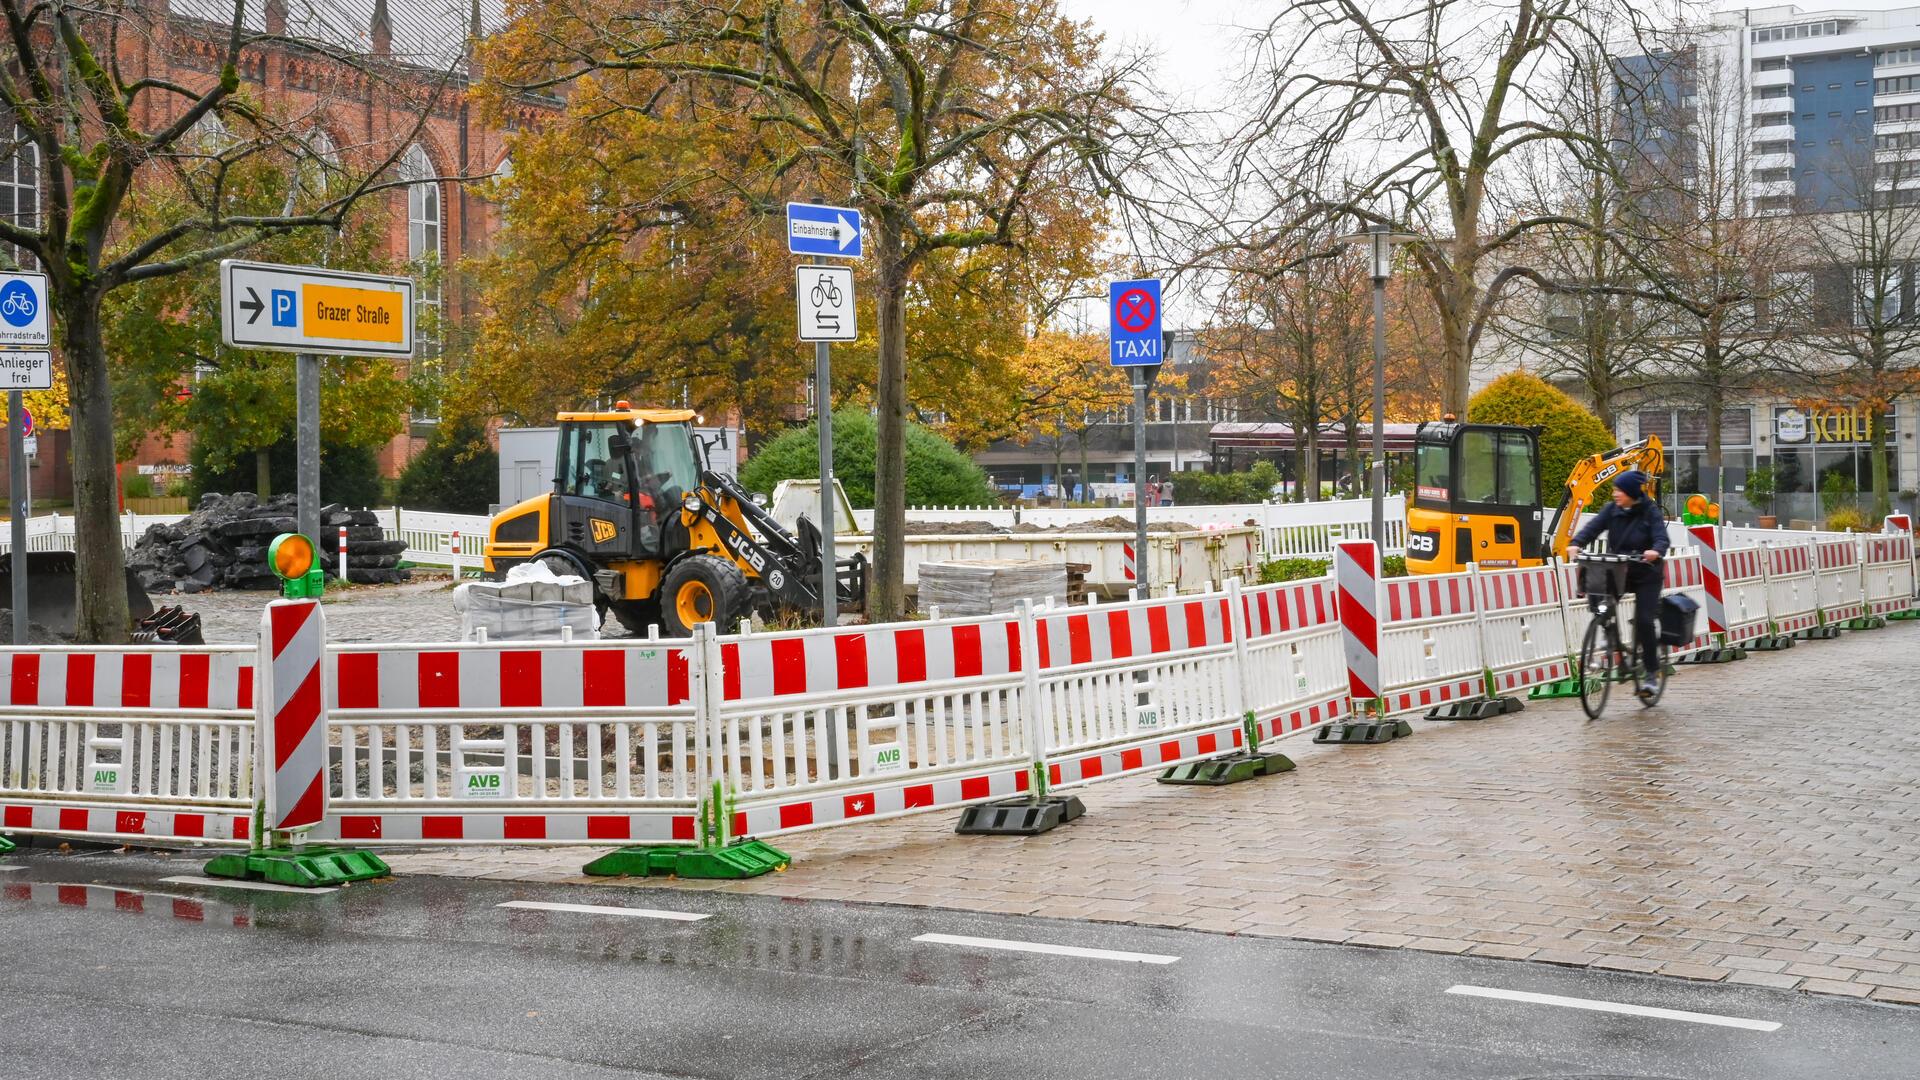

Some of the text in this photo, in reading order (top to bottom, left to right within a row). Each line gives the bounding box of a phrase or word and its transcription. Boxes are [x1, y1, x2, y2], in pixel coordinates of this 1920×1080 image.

[277, 294, 390, 325] P Grazer Straße
[0, 330, 46, 340] hrradstraße
[1115, 338, 1157, 358] TAXI
[0, 356, 43, 371] Anlieger
[12, 371, 31, 384] frei
[1593, 463, 1618, 484] JCB
[594, 520, 616, 541] JCB
[1408, 533, 1434, 552] JCB
[728, 529, 766, 573] JCB
[771, 573, 781, 586] 20
[1138, 711, 1158, 725] AVB
[877, 749, 901, 764] AVB
[95, 770, 117, 783] AVB
[468, 774, 500, 788] AVB
